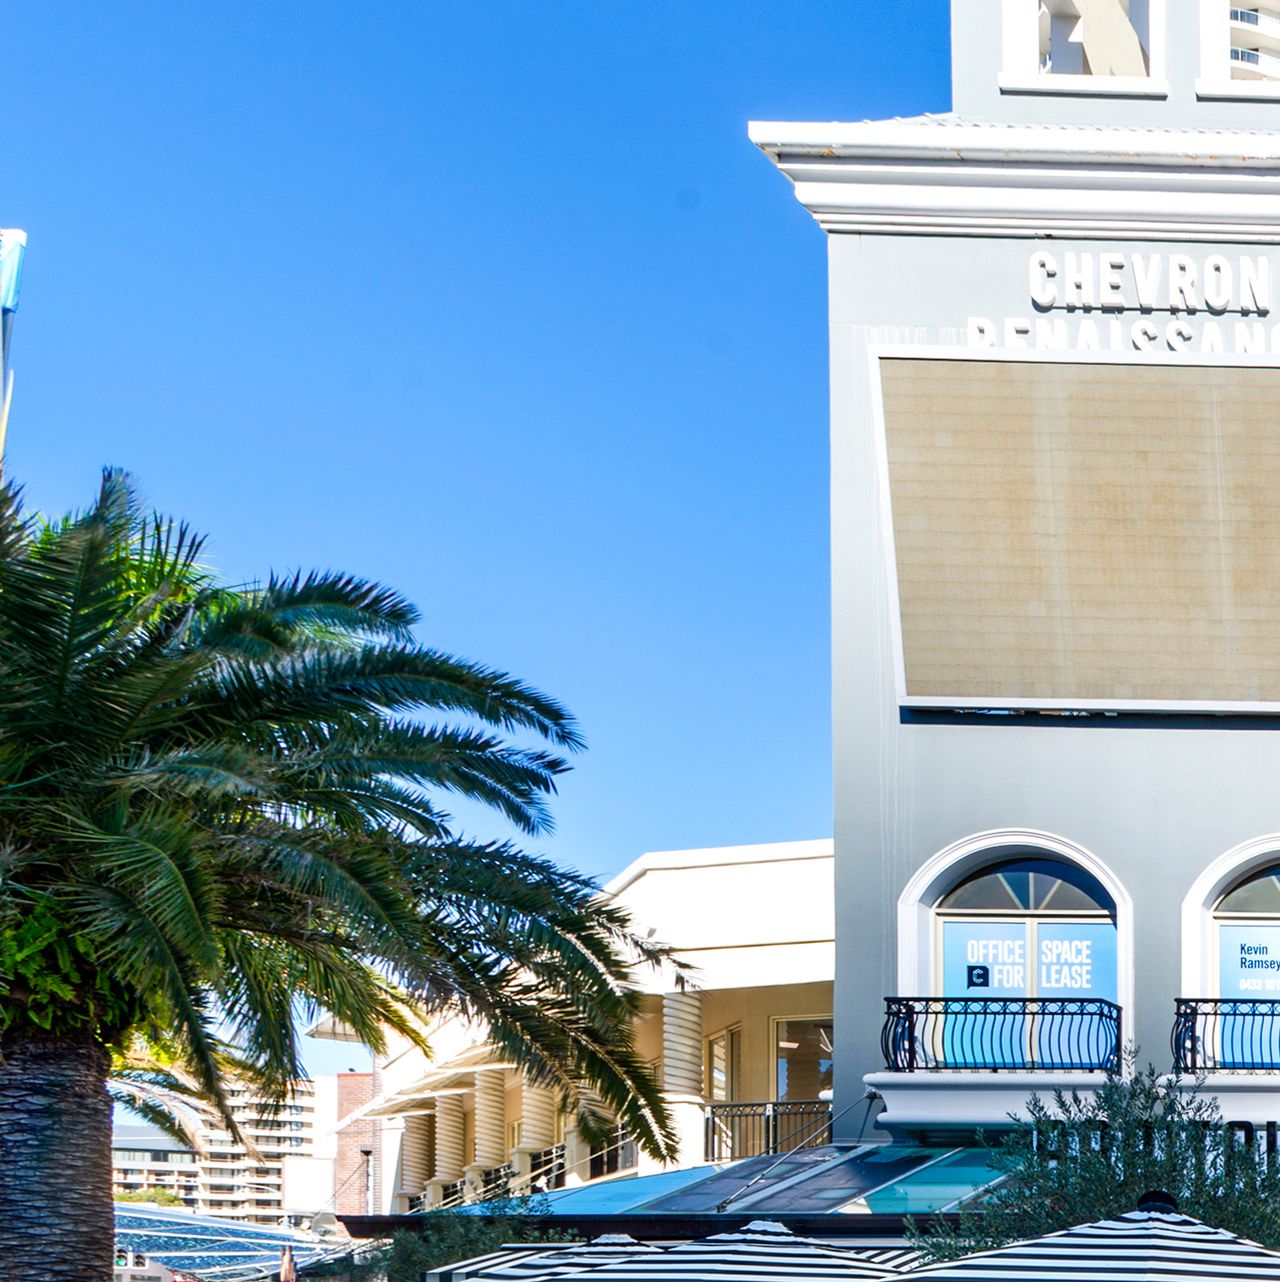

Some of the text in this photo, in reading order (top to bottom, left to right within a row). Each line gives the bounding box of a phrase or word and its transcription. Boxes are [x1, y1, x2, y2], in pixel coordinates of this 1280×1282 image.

[1029, 251, 1272, 313] CHEVRON
[967, 939, 1092, 964] OFFICE SPACE
[1240, 943, 1269, 956] Kevin
[993, 965, 1024, 989] FOR
[1041, 966, 1092, 989] LEASE
